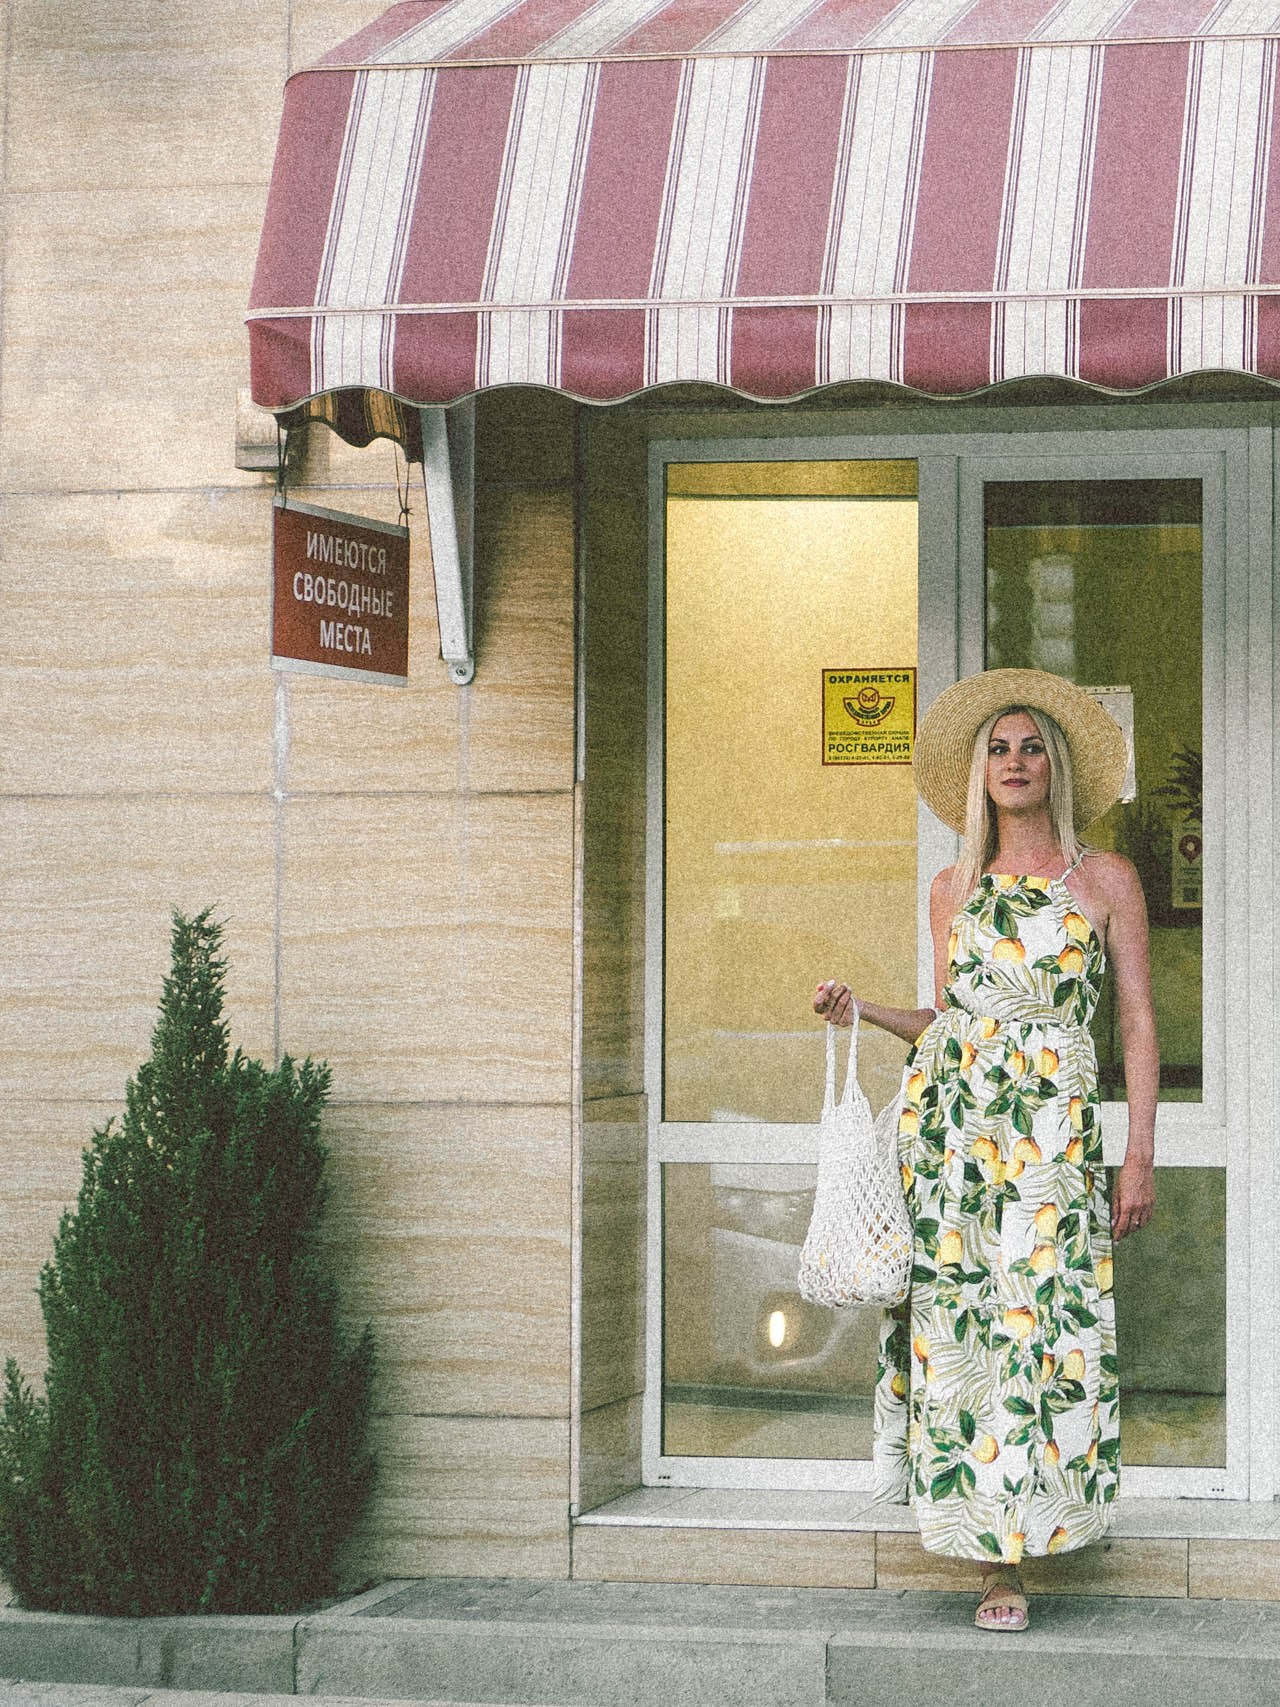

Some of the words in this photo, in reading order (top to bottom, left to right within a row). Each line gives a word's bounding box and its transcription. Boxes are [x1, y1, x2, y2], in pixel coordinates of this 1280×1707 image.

[306, 531, 387, 575] ИМЕЮТСЯ
[292, 571, 393, 618] СВОБОДНЫЕ
[319, 619, 372, 656] МЕСТА
[828, 674, 910, 684] ОХРАНЯЕТСЯ
[828, 743, 910, 753] РОСГВАРДИЯ
